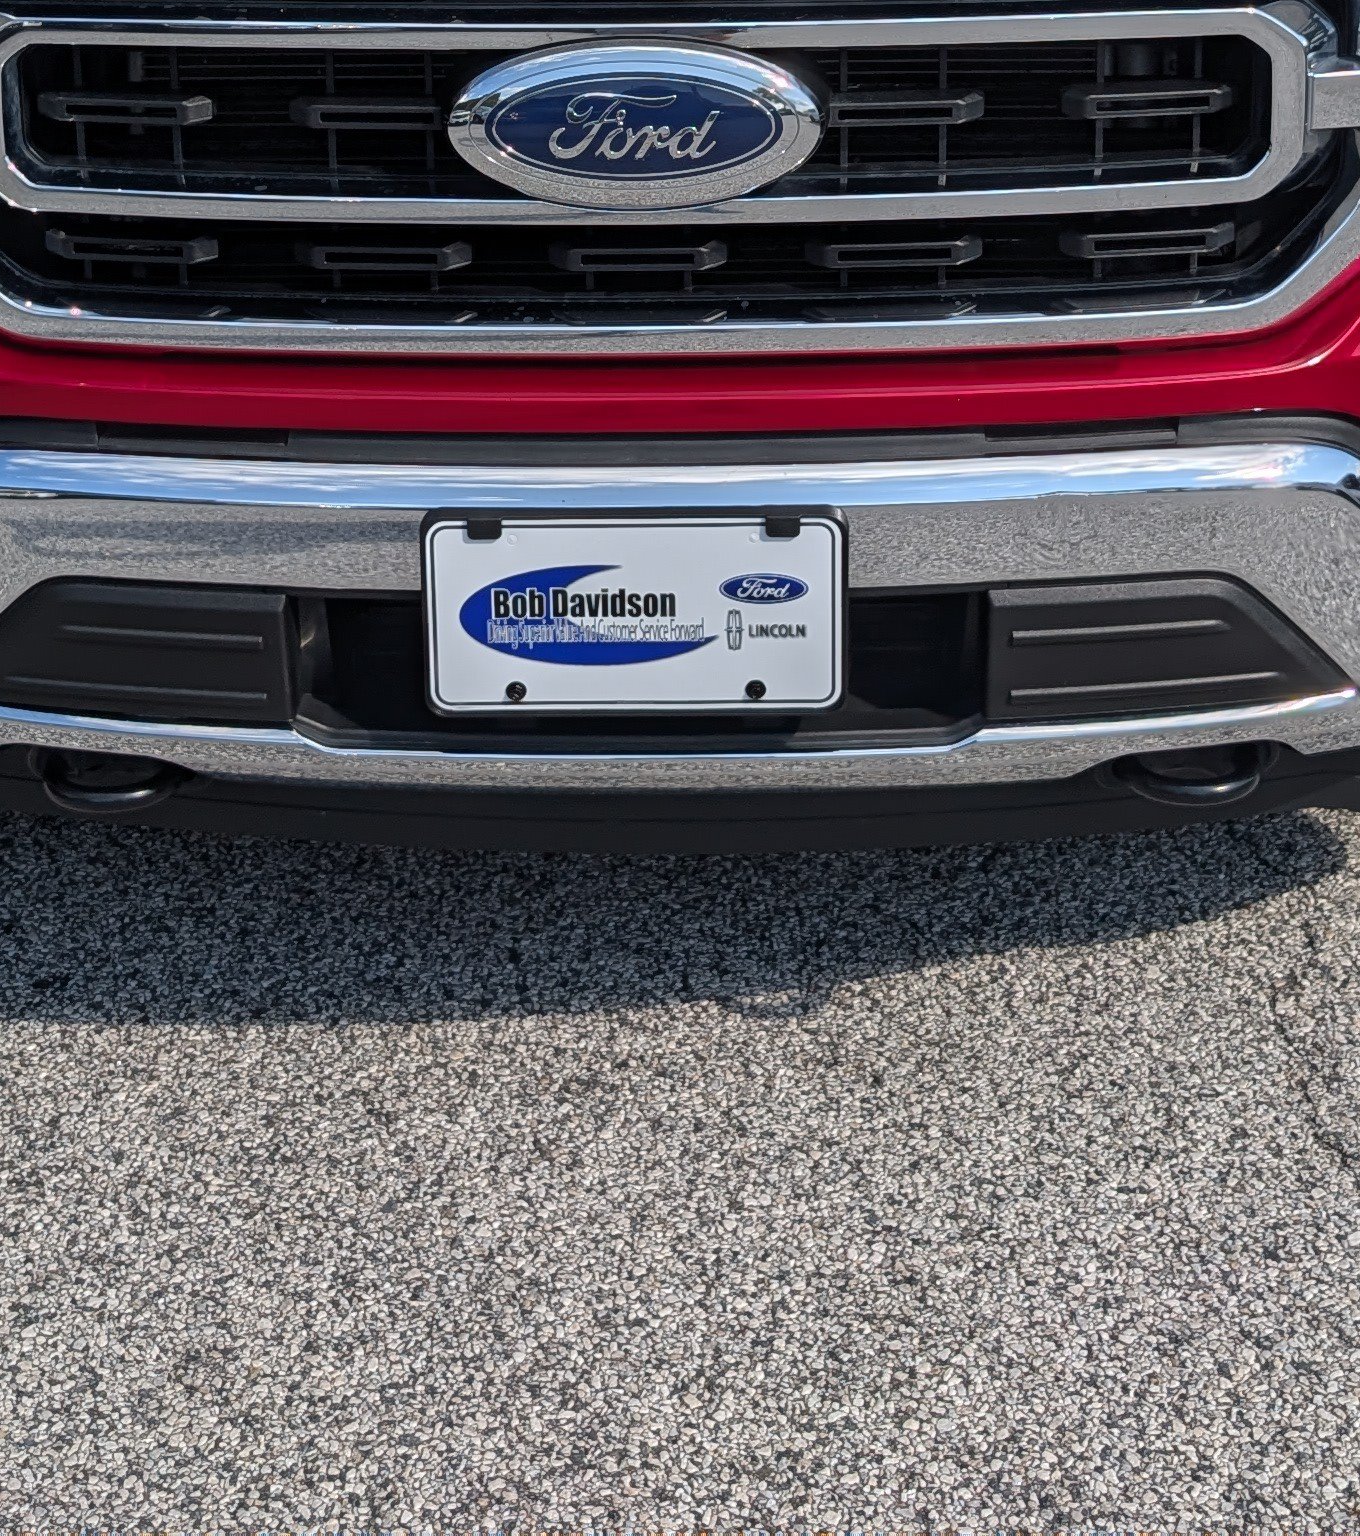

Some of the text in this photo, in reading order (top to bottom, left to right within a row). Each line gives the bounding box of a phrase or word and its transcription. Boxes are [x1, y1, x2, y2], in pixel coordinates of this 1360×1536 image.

[548, 91, 721, 161] Ford
[736, 577, 791, 598] Ford
[492, 587, 677, 619] Bob Davidson
[597, 618, 638, 642] Customer
[639, 618, 669, 642] Service
[670, 616, 705, 642] Forward
[748, 624, 807, 638] LINCOLN
